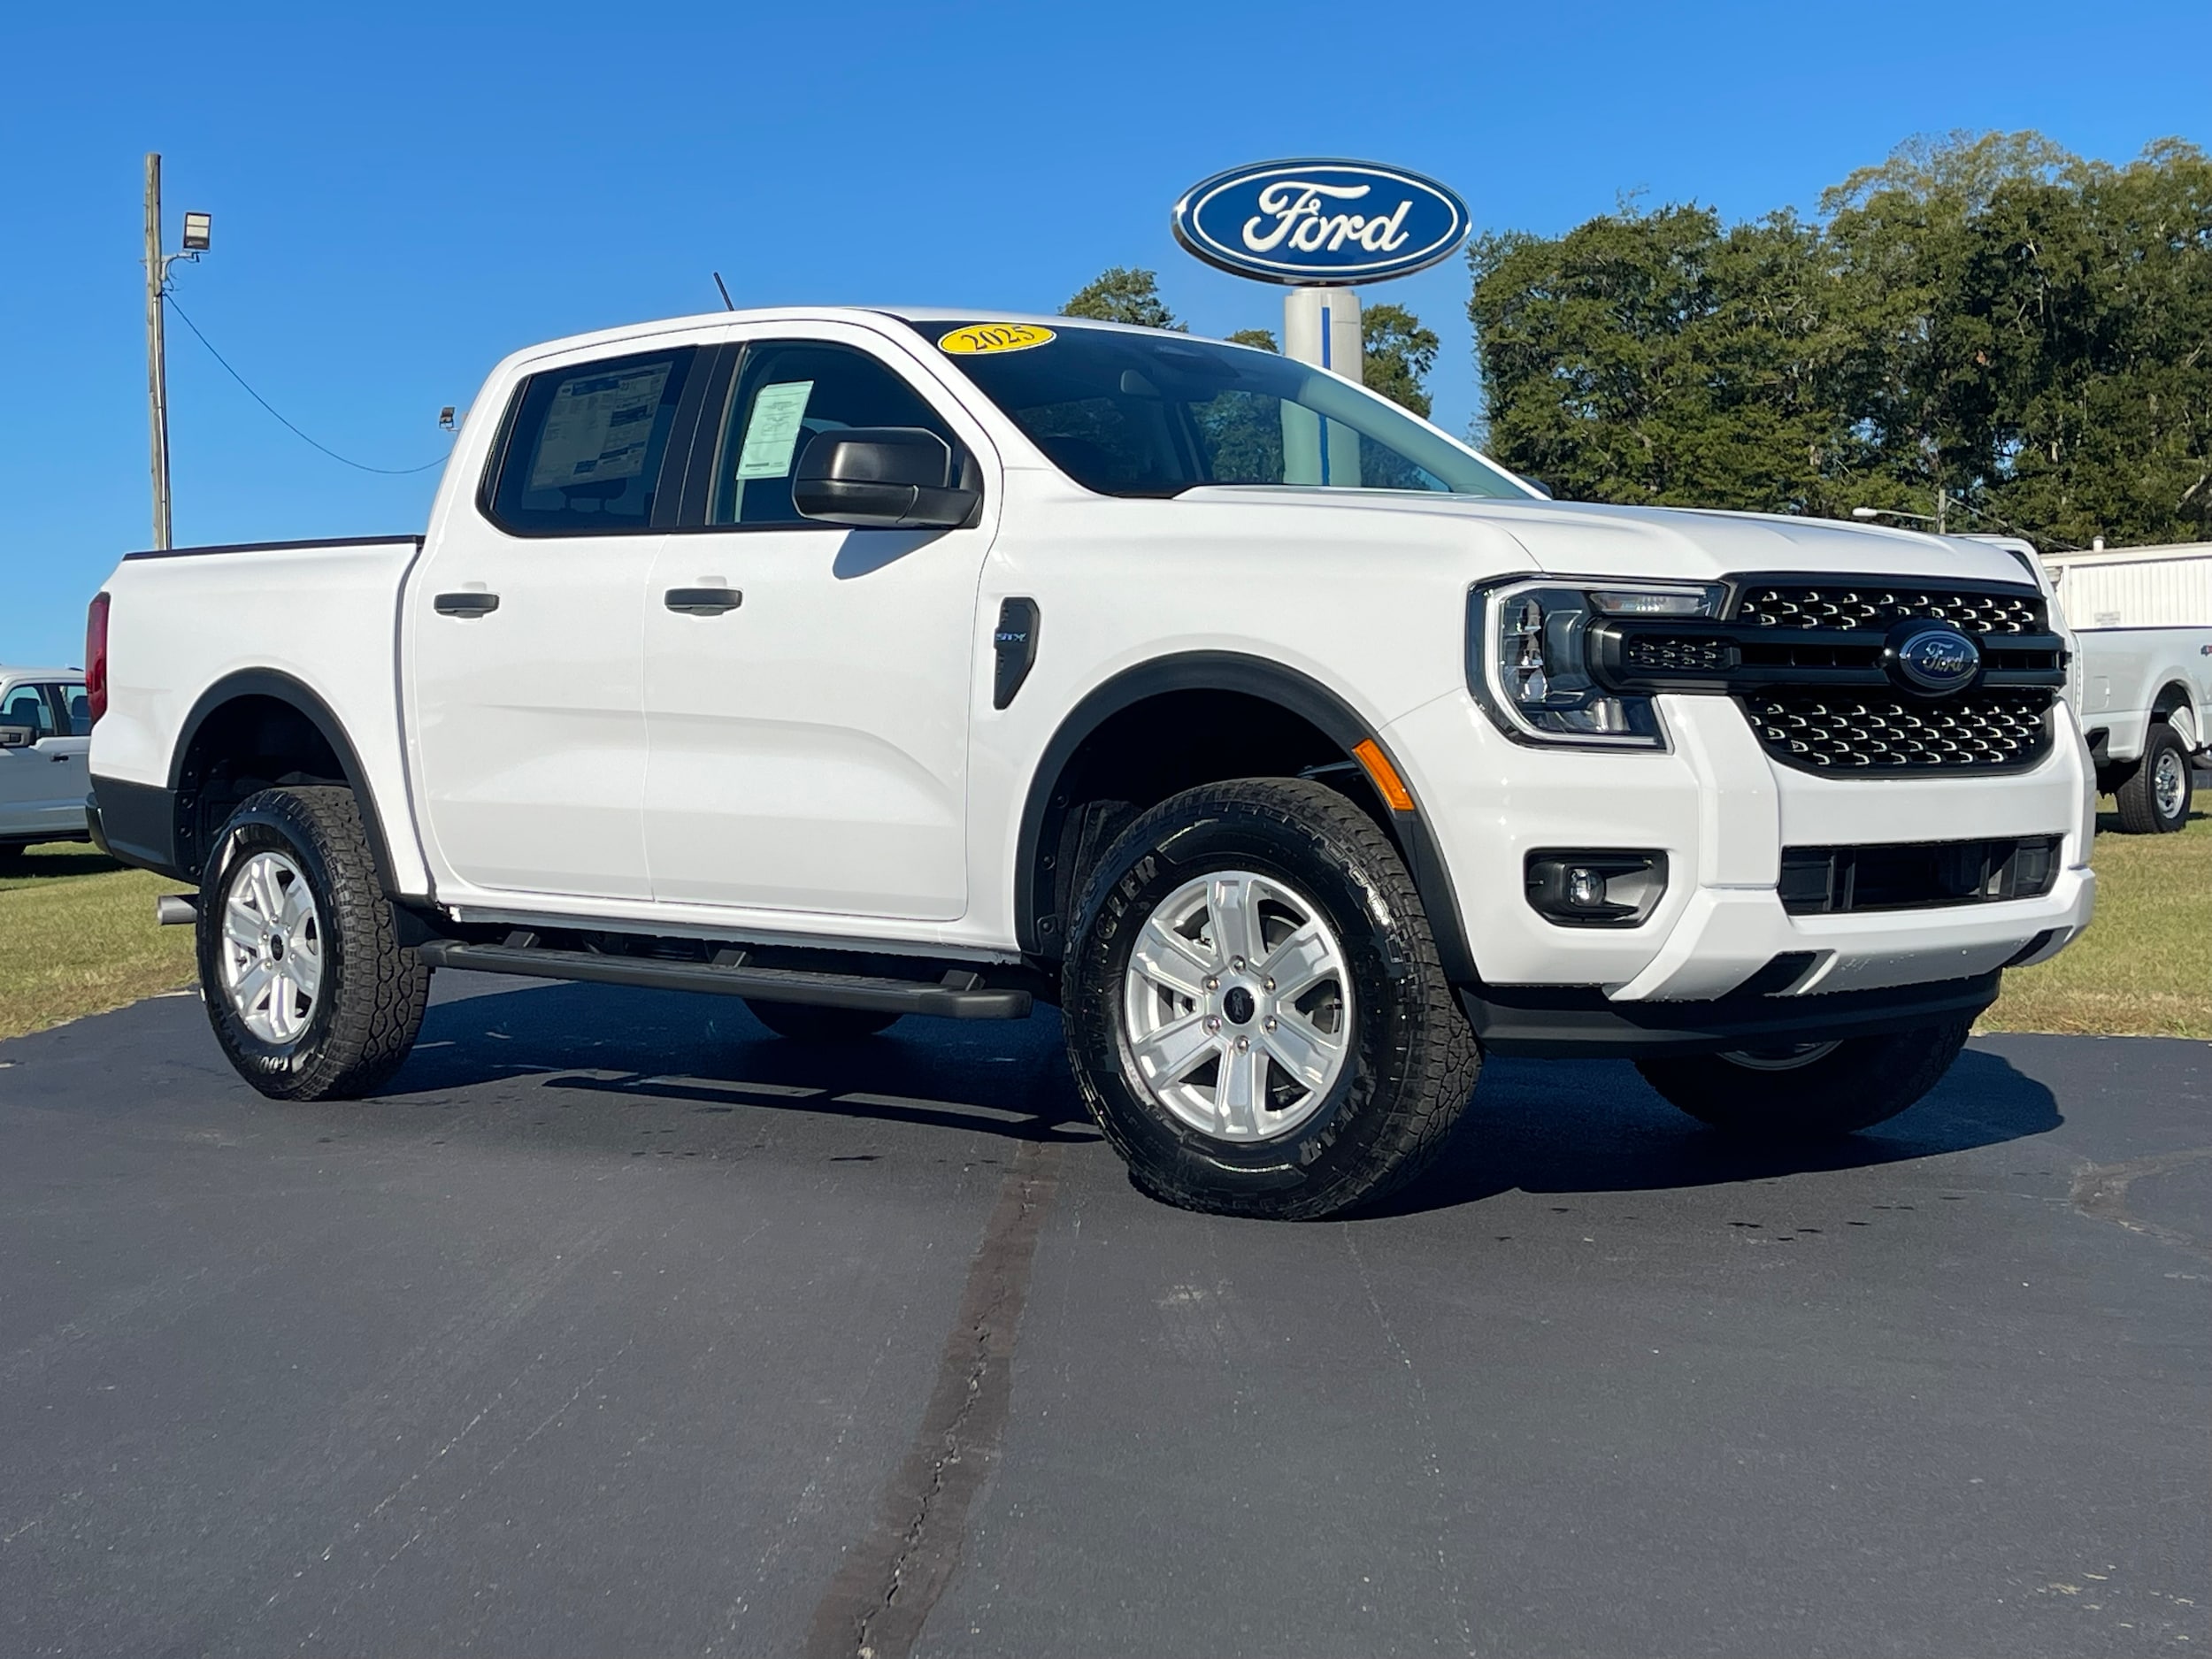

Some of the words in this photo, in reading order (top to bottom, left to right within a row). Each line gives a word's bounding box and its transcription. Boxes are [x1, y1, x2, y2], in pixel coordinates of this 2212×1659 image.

[1242, 180, 1413, 252] Ford
[961, 326, 1035, 350] 2025
[1923, 641, 1964, 672] Ford
